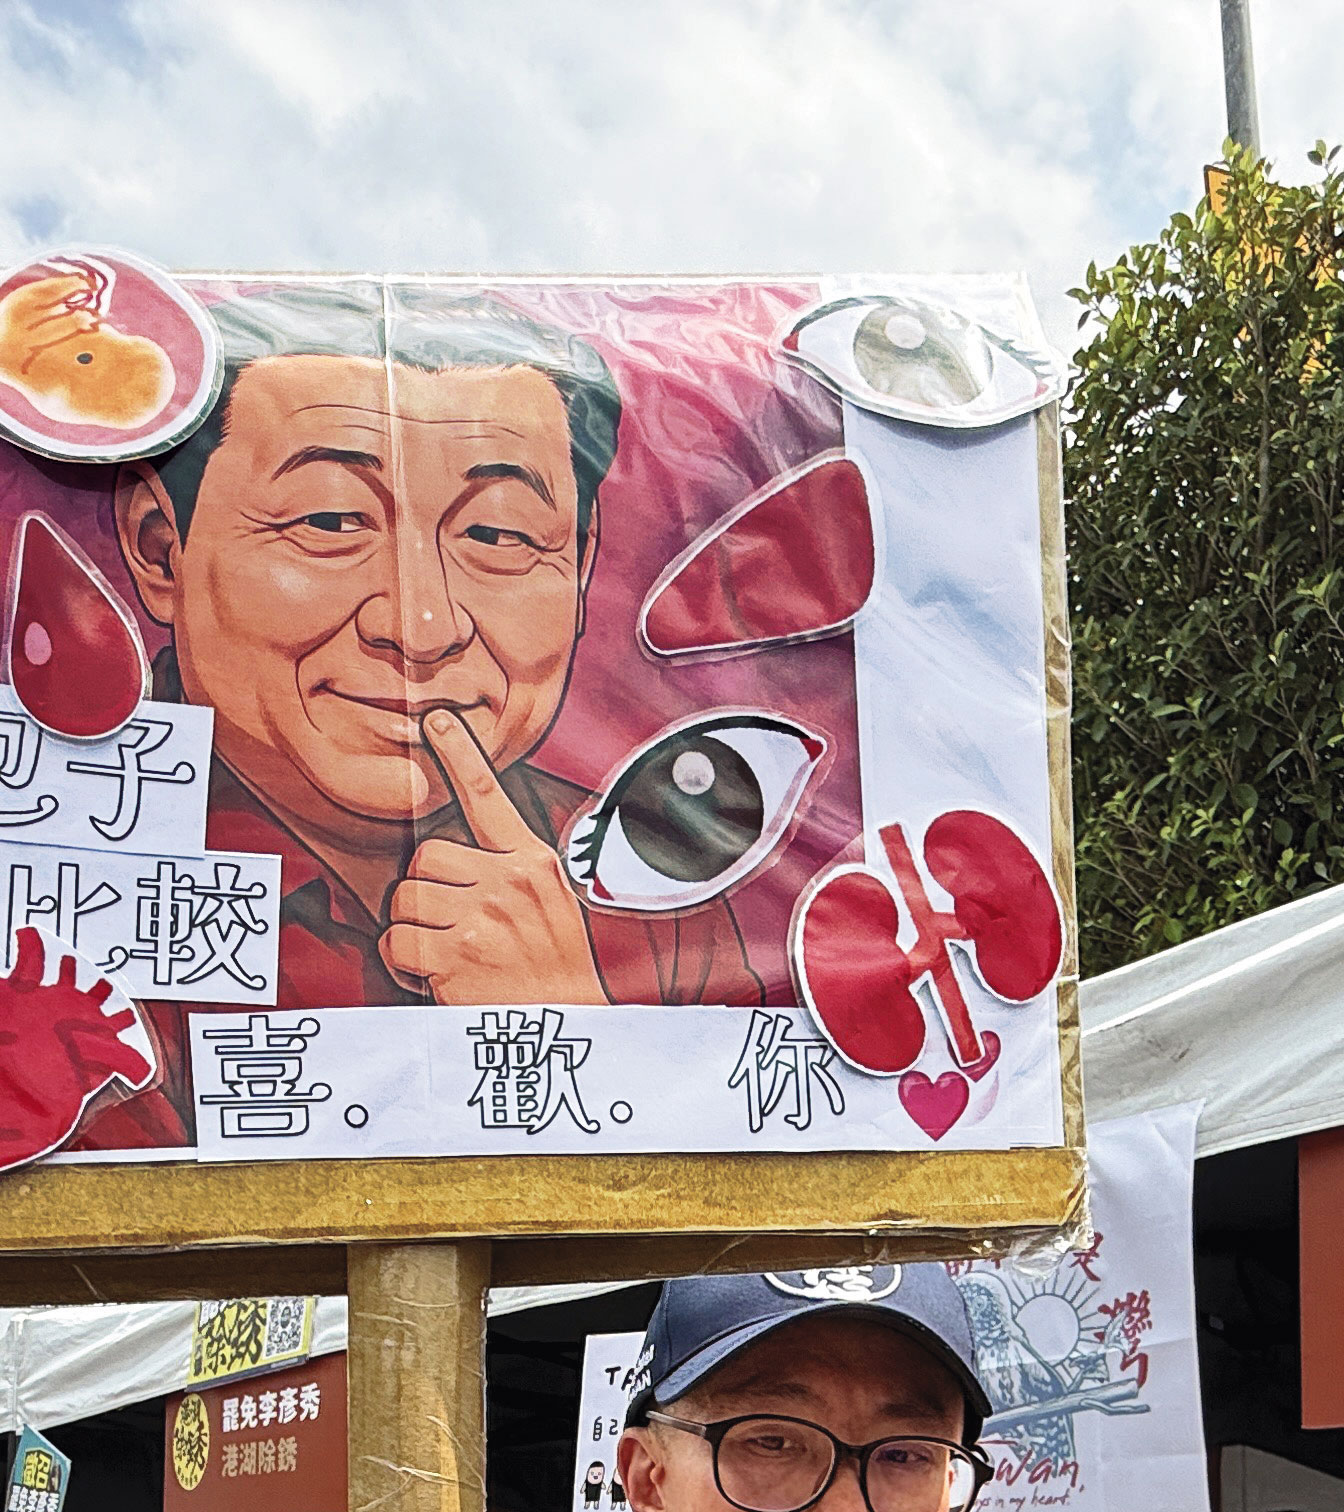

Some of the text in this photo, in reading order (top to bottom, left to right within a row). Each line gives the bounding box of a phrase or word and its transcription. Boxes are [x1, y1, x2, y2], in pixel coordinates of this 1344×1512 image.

[222, 1382, 321, 1433] 罷免李彥秀
